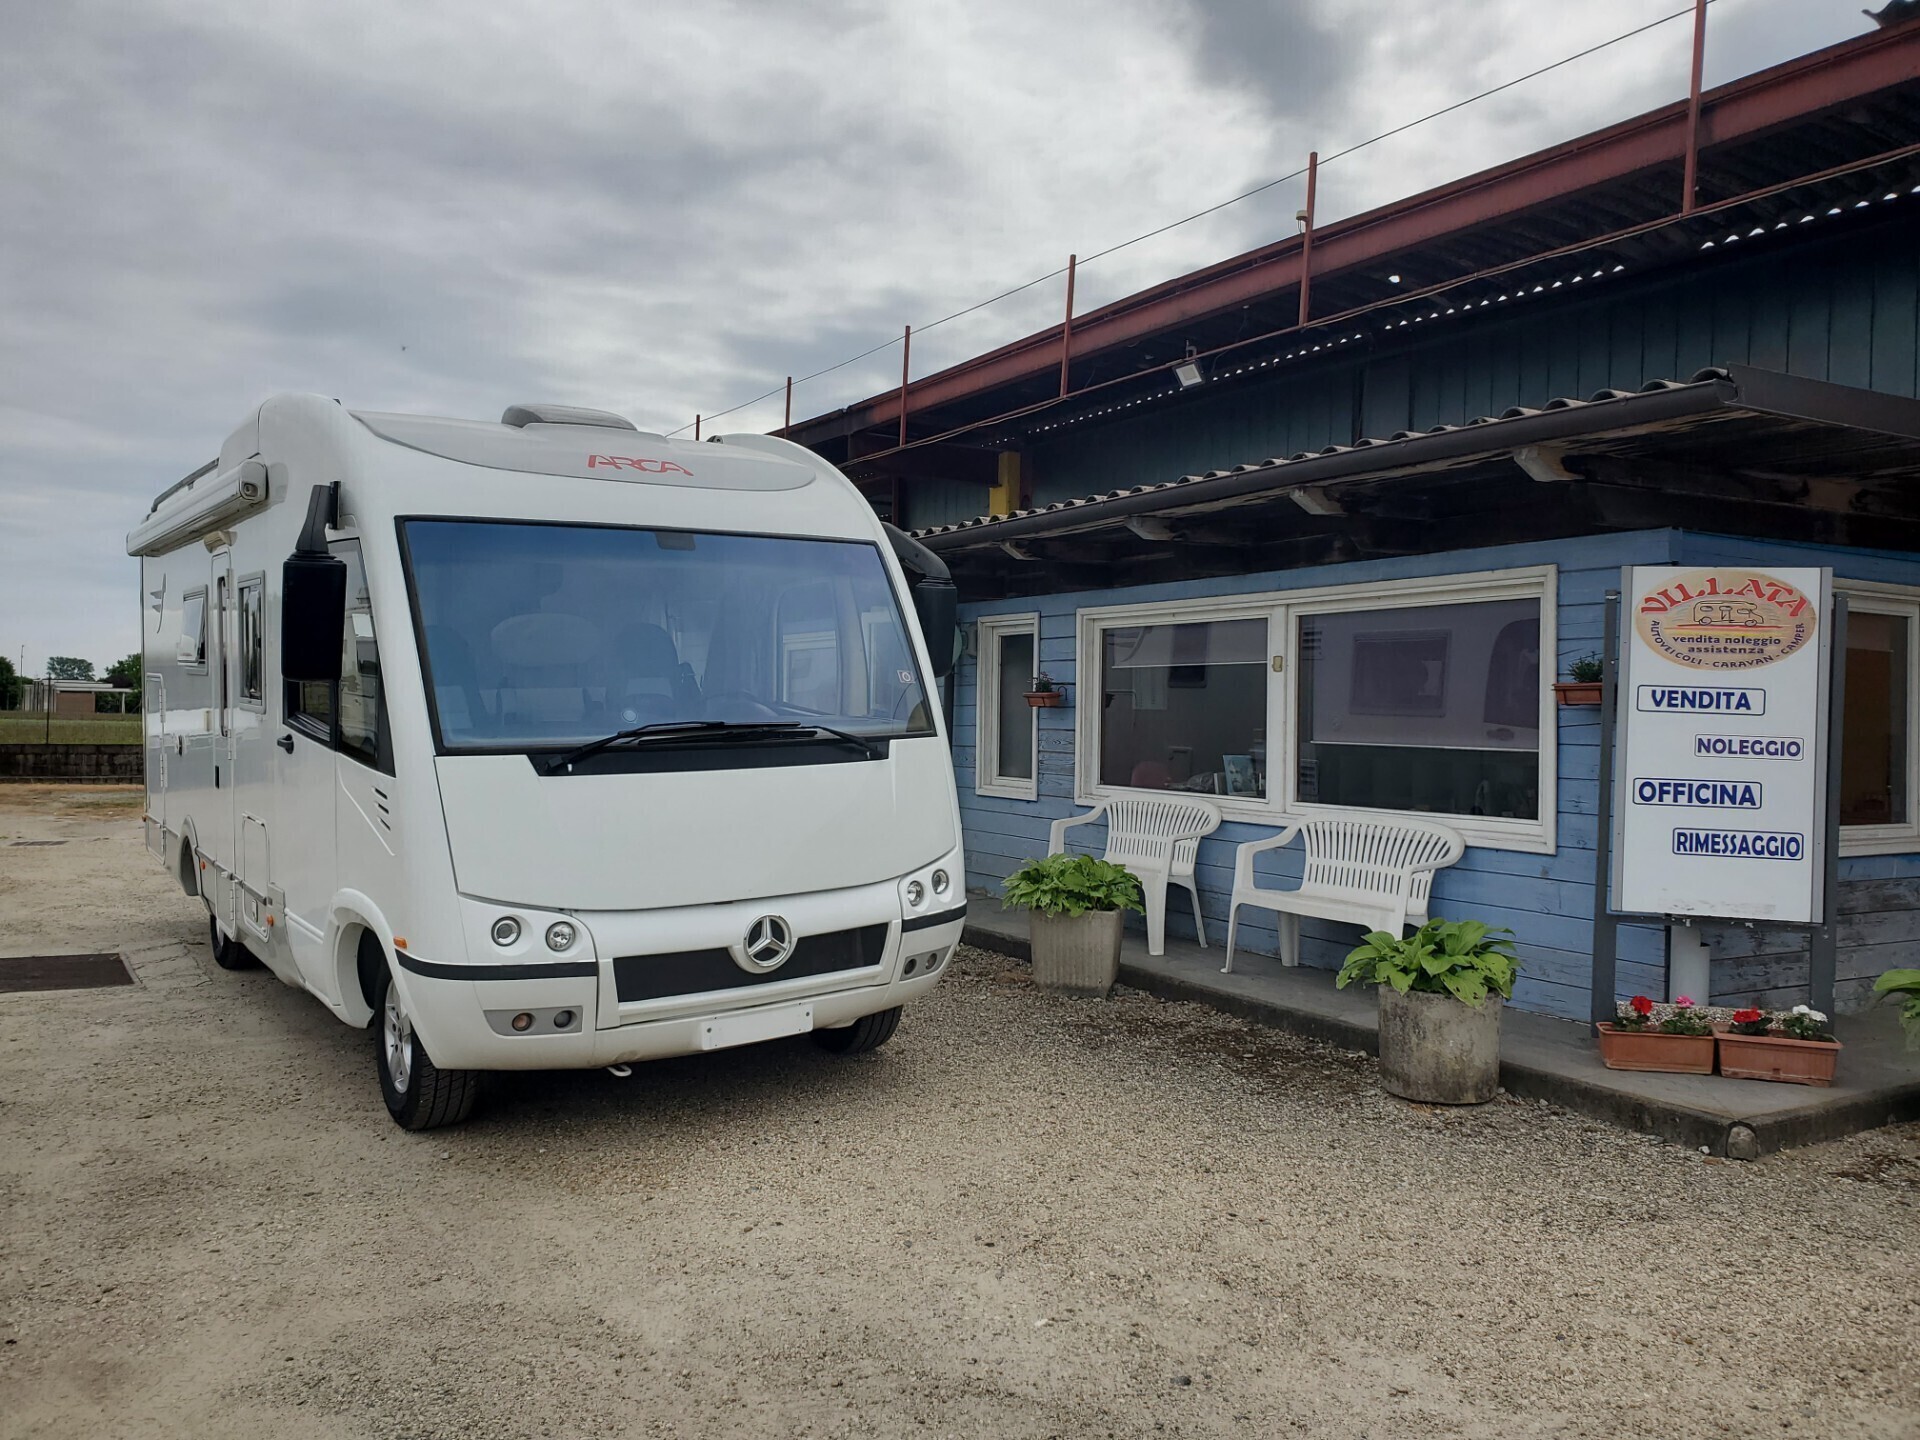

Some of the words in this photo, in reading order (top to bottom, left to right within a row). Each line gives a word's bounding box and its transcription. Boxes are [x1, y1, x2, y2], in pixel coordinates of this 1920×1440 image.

[587, 455, 694, 477] ARCA
[1640, 577, 1808, 617] VILLATA
[1650, 620, 1703, 666] AUTOVEICOLI
[1712, 654, 1775, 669] CARAVAN
[1780, 622, 1805, 655] CAMPER
[1672, 634, 1720, 645] vendita
[1724, 636, 1781, 647] noleggio
[1687, 645, 1765, 655] assistenza
[1651, 689, 1752, 711] VENDITA
[1697, 738, 1802, 757] NOLEGGIO
[1638, 781, 1757, 807] OFFICINA
[1676, 832, 1801, 858] RIMESSAGGIO
